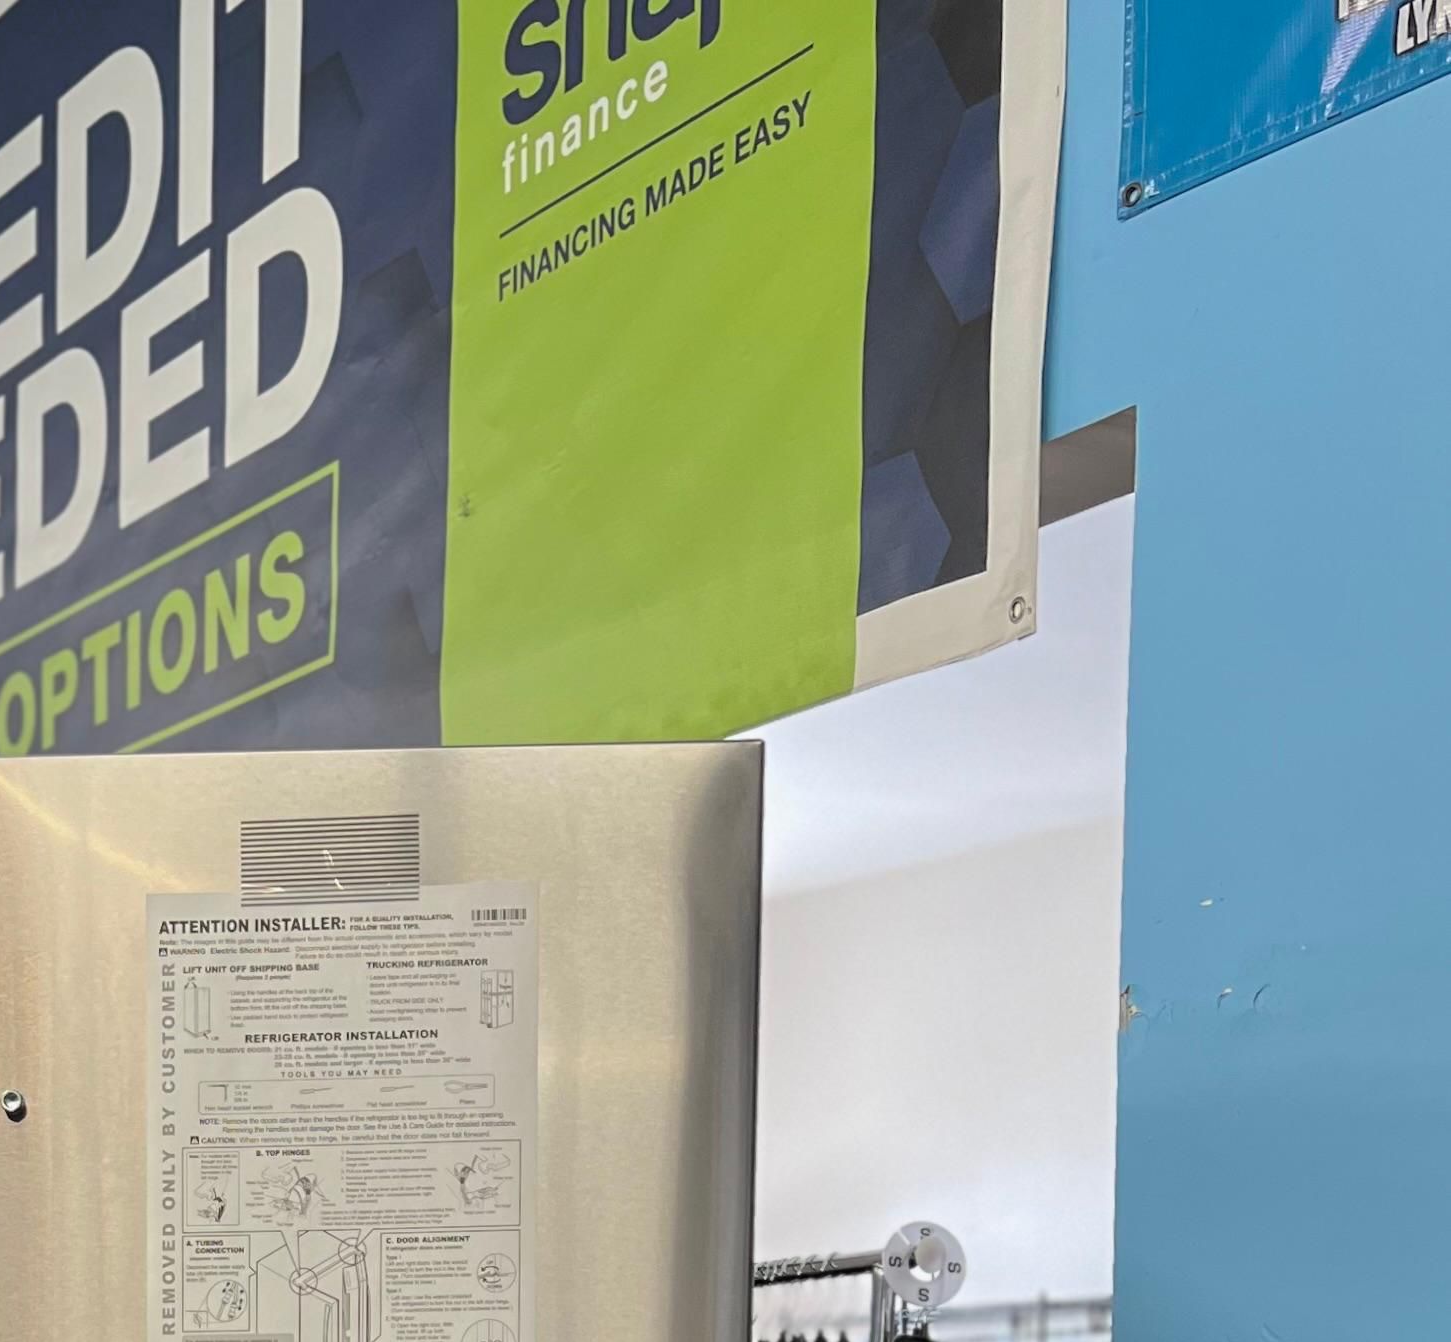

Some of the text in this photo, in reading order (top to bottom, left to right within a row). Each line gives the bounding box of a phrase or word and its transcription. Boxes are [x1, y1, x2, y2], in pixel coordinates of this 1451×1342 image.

[502, 60, 669, 195] finance
[497, 91, 813, 302] FINANCING MADE EASY
[159, 917, 346, 935] ATTENTION INSTALLER:
[183, 963, 320, 974] LIFT UNIT OFF SHIPPING BASE
[366, 958, 488, 969] TRUCKING REFRIGERATOR
[162, 963, 176, 1093] CUSTOMER
[245, 1029, 439, 1043] REFRIGERATOR INSTALLATION
[374, 1068, 402, 1076] NEED
[162, 1106, 176, 1137] BY
[162, 1150, 176, 1211] ONLY
[422, 1235, 471, 1243] ALIGNMENT
[162, 1223, 176, 1335] REMOVED
[918, 1288, 929, 1302] S
